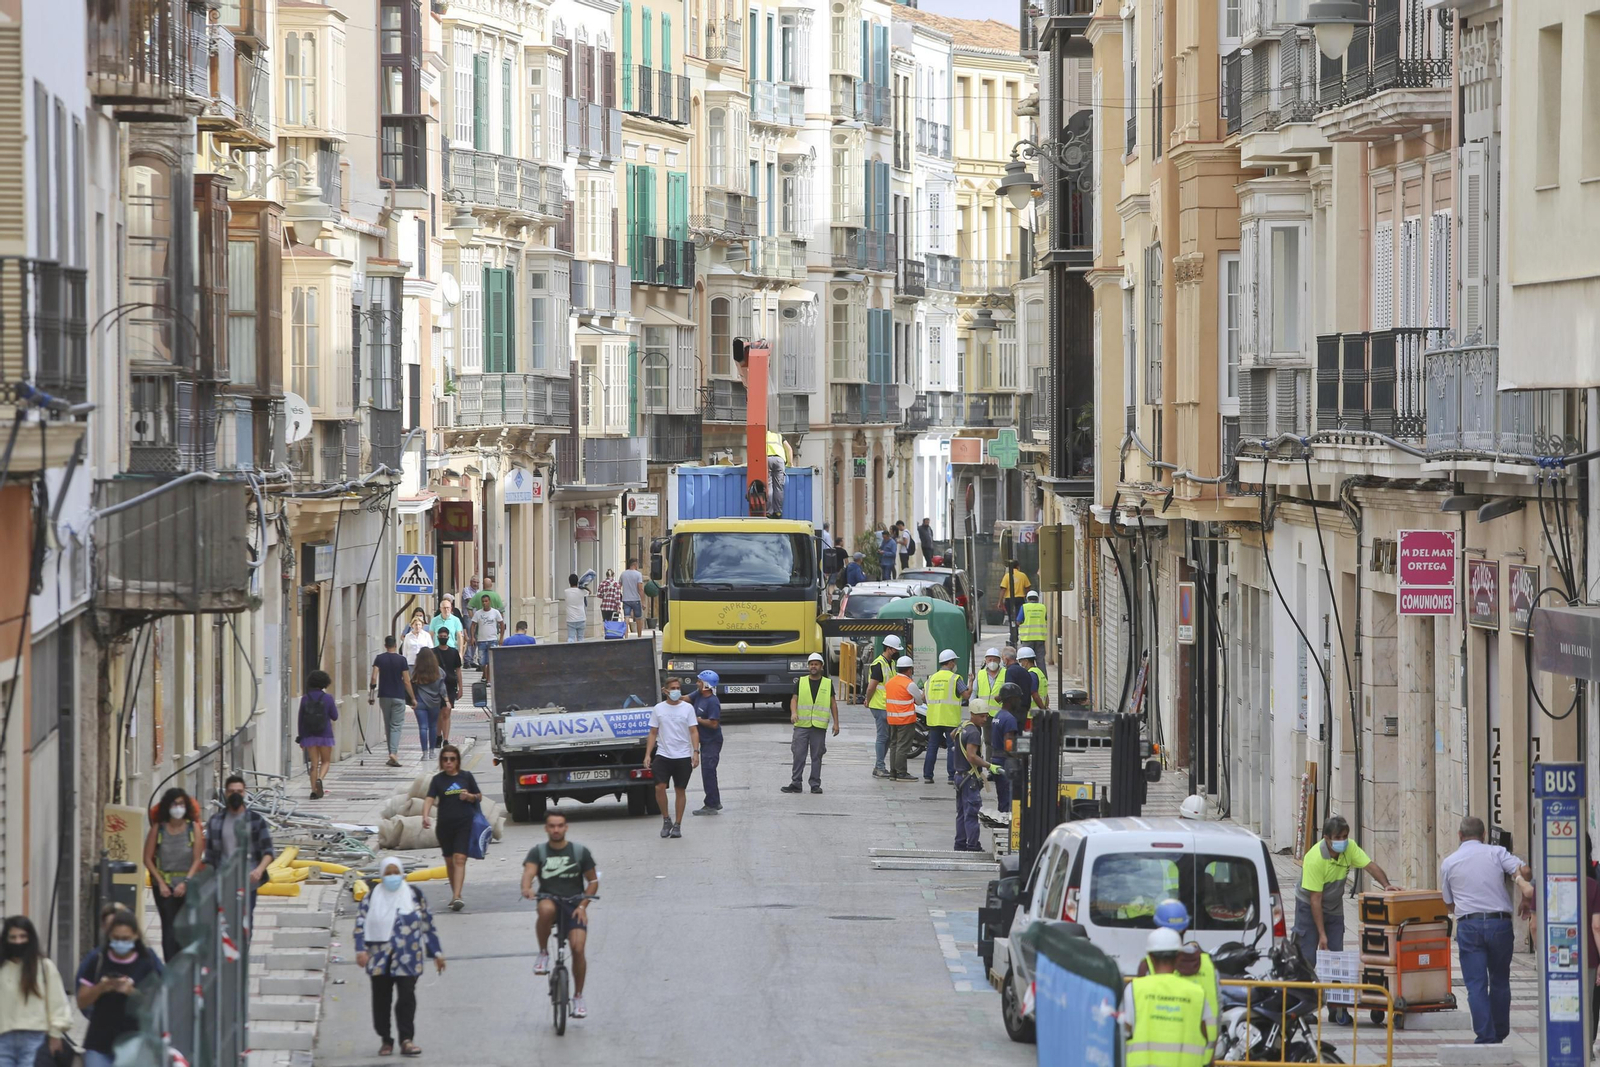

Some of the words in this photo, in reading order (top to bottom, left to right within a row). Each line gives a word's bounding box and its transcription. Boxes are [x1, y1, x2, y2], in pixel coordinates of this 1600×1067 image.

[1401, 549, 1410, 557] M
[1412, 549, 1430, 557] DEL
[1431, 549, 1453, 557] MAR
[1407, 562, 1447, 571] ORTEGA
[1402, 594, 1452, 609] COMUNIONES
[717, 602, 768, 626] COMPRESORES
[511, 718, 604, 738] ANANSA
[613, 722, 627, 730] 952
[627, 721, 637, 729] 04
[573, 771, 590, 780] 1077
[1545, 771, 1576, 792] BUS
[1551, 821, 1572, 836] 36
